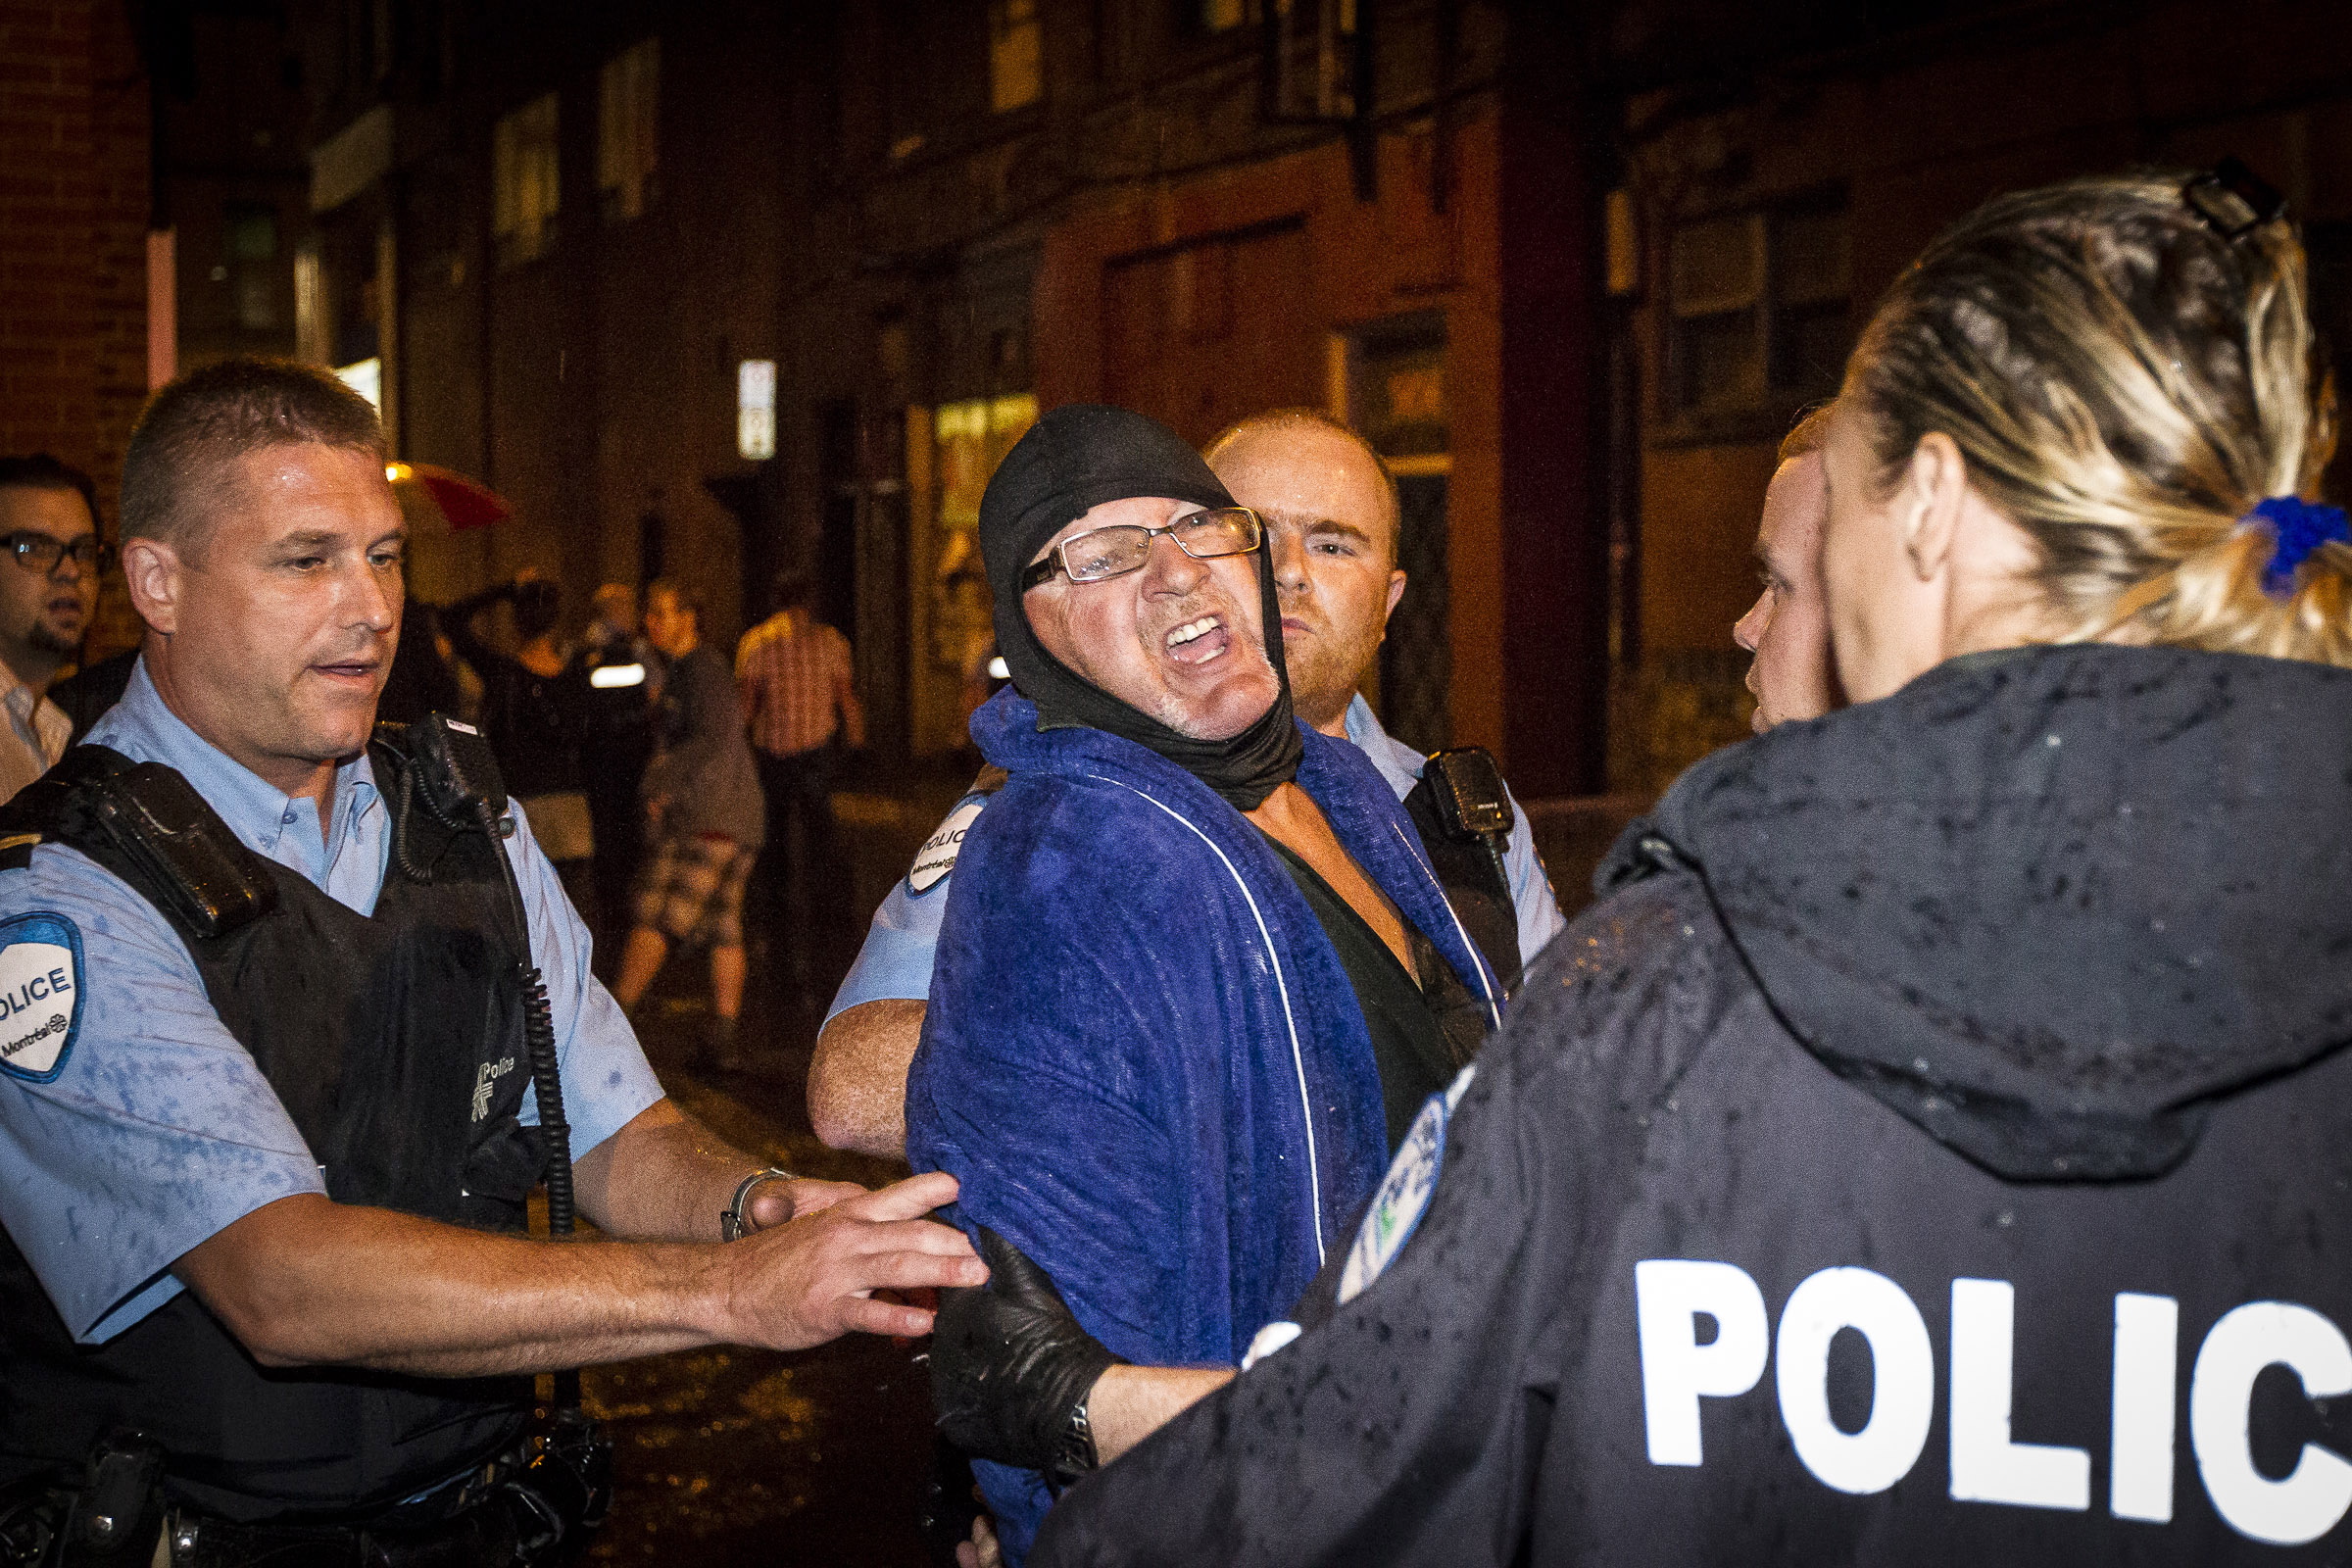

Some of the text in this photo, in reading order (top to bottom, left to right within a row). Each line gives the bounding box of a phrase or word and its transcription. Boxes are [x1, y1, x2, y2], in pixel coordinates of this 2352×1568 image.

[2, 1023, 51, 1058] Montréal
[479, 1057, 514, 1080] Police
[1635, 1259, 2352, 1544] POLIC
